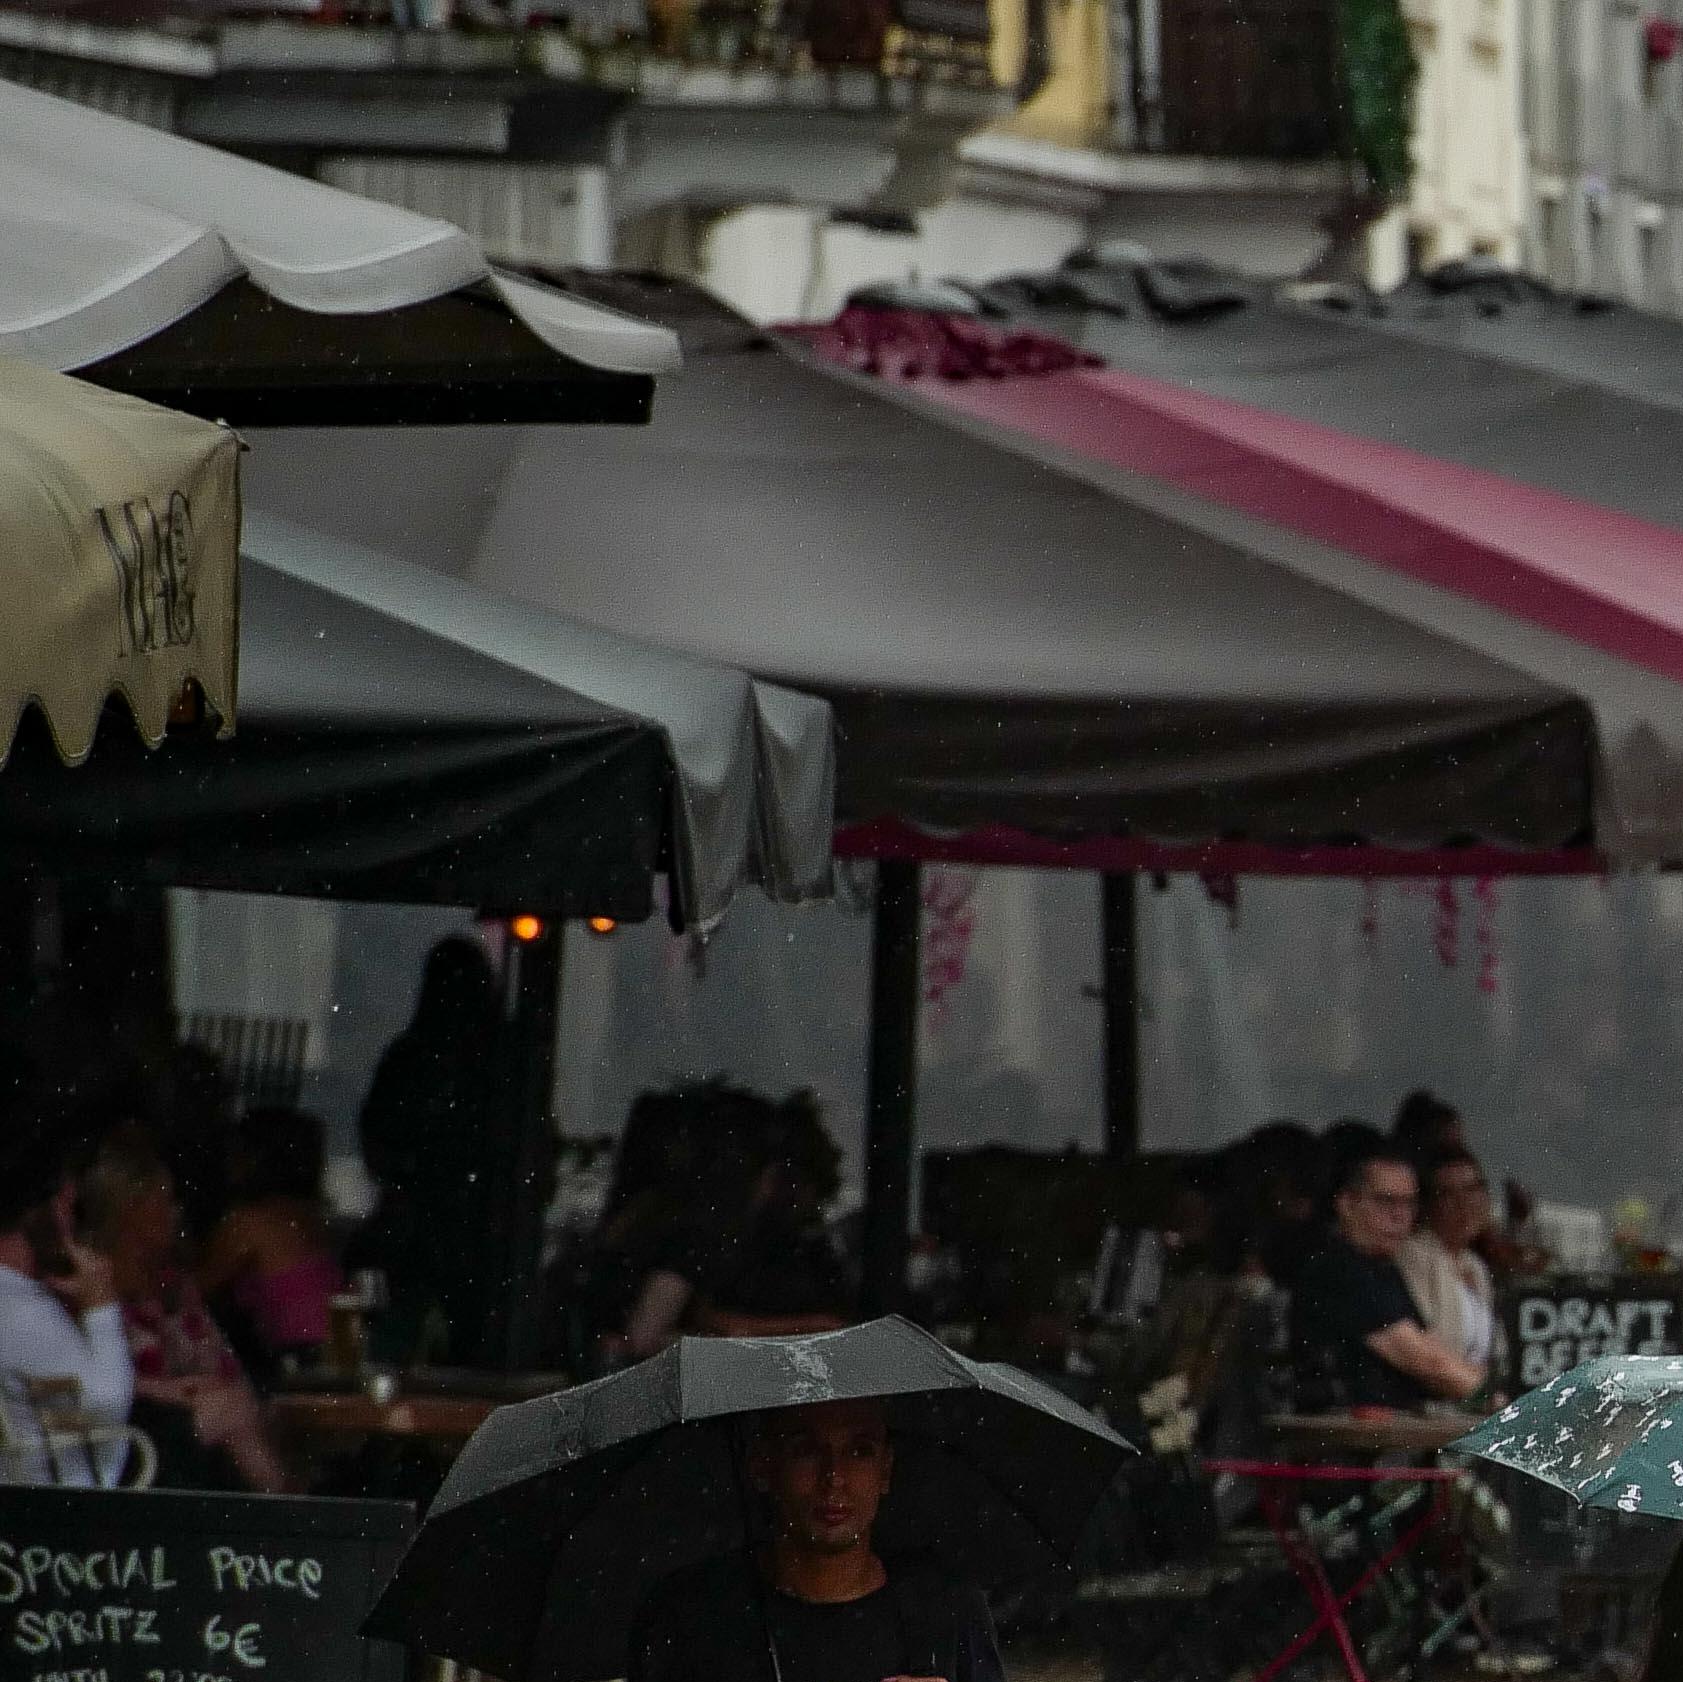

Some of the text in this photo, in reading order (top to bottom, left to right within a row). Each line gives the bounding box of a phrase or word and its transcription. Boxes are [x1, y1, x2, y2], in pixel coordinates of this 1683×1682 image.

[1519, 1299, 1673, 1341] DRAFT
[15, 1606, 267, 1668] SPRITZ 6€
